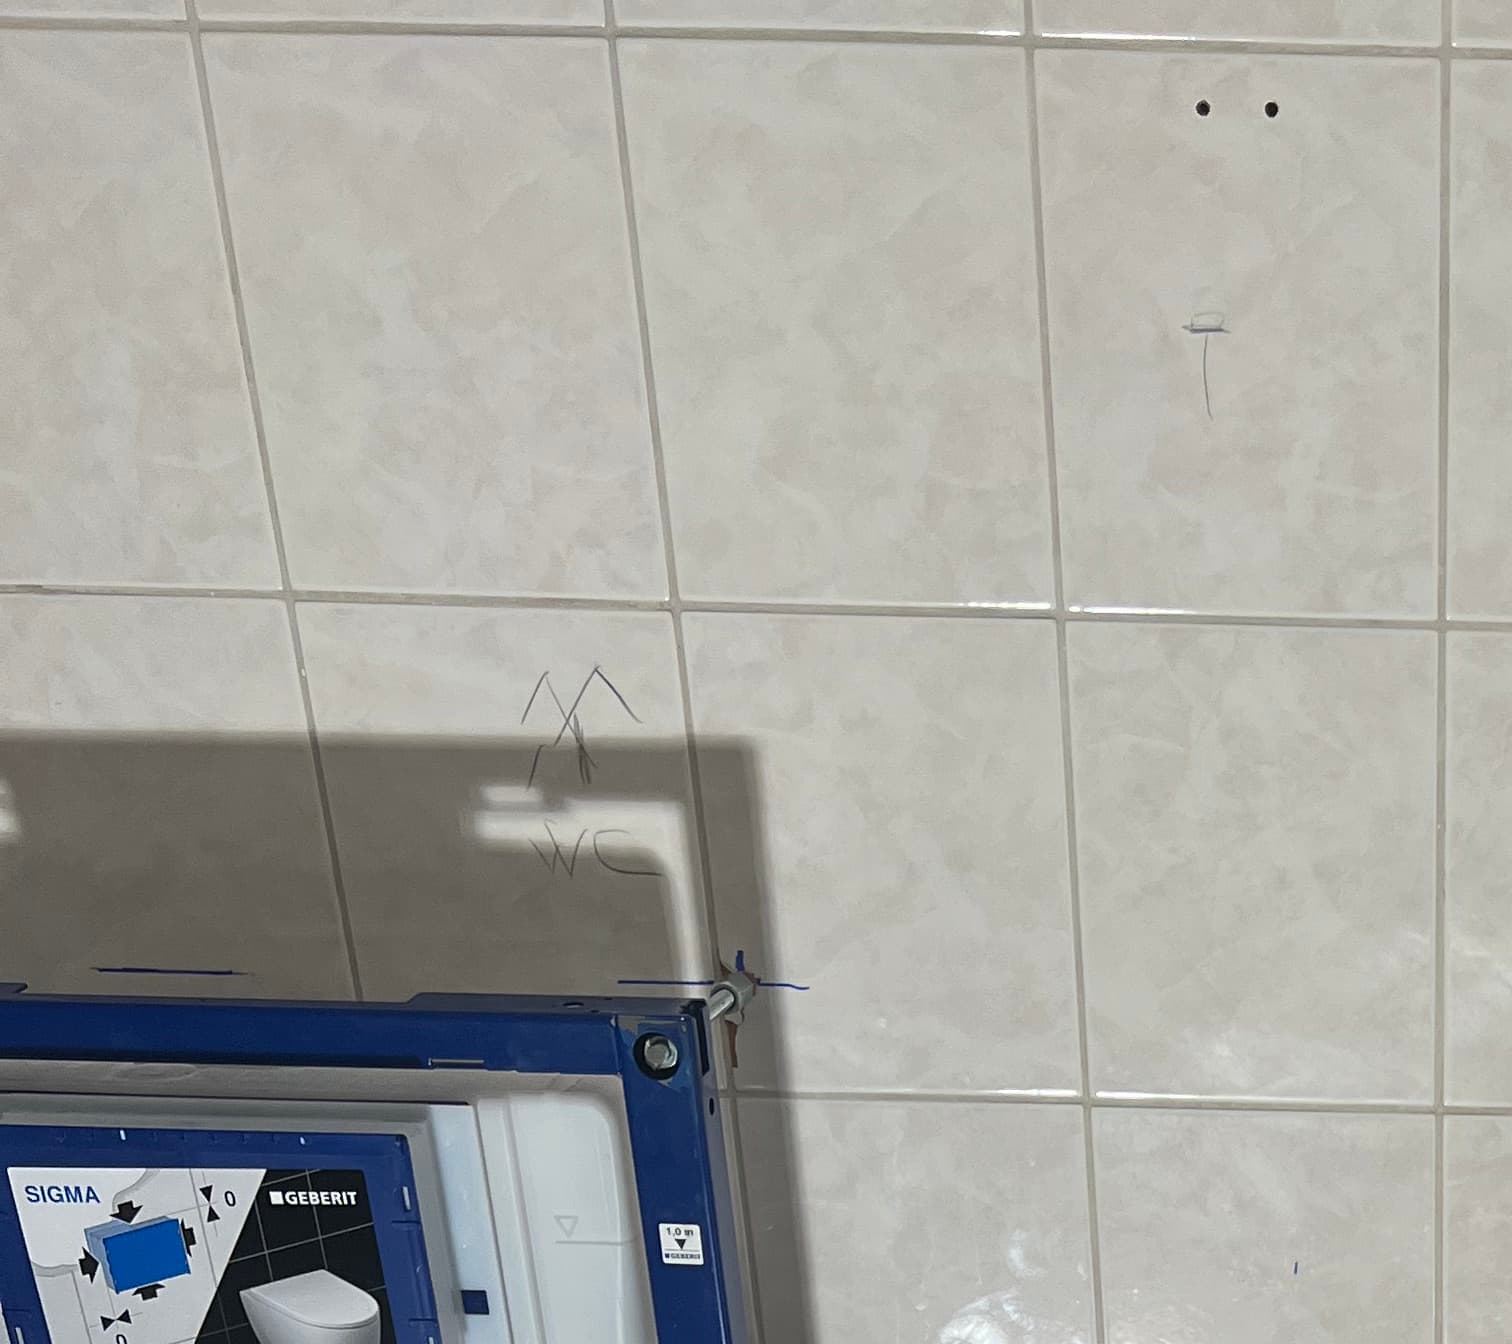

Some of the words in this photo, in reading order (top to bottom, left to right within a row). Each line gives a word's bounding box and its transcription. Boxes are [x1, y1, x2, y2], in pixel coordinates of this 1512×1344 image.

[25, 1184, 101, 1204] SIGMA
[223, 1190, 236, 1207] 0
[284, 1190, 357, 1206] GEBERIT
